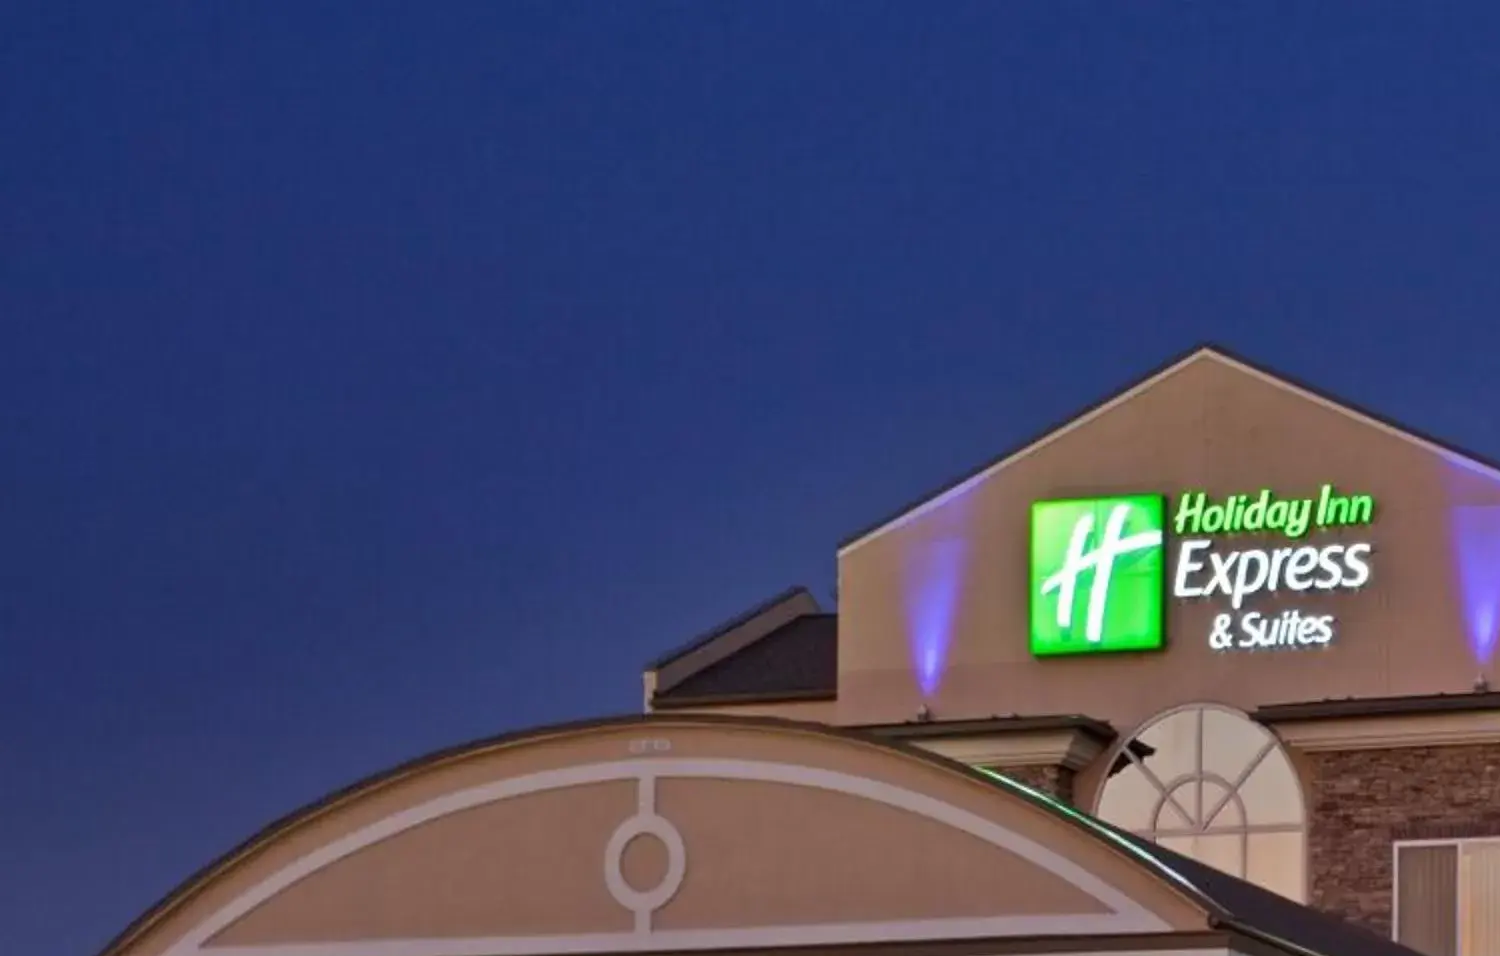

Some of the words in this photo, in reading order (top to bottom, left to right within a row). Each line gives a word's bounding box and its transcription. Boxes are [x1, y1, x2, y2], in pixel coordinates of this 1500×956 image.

[1174, 489, 1311, 537] Holiday
[1316, 484, 1373, 527] Inn
[1174, 539, 1372, 609] Express
[1209, 613, 1233, 650] &
[1238, 610, 1334, 649] Suites
